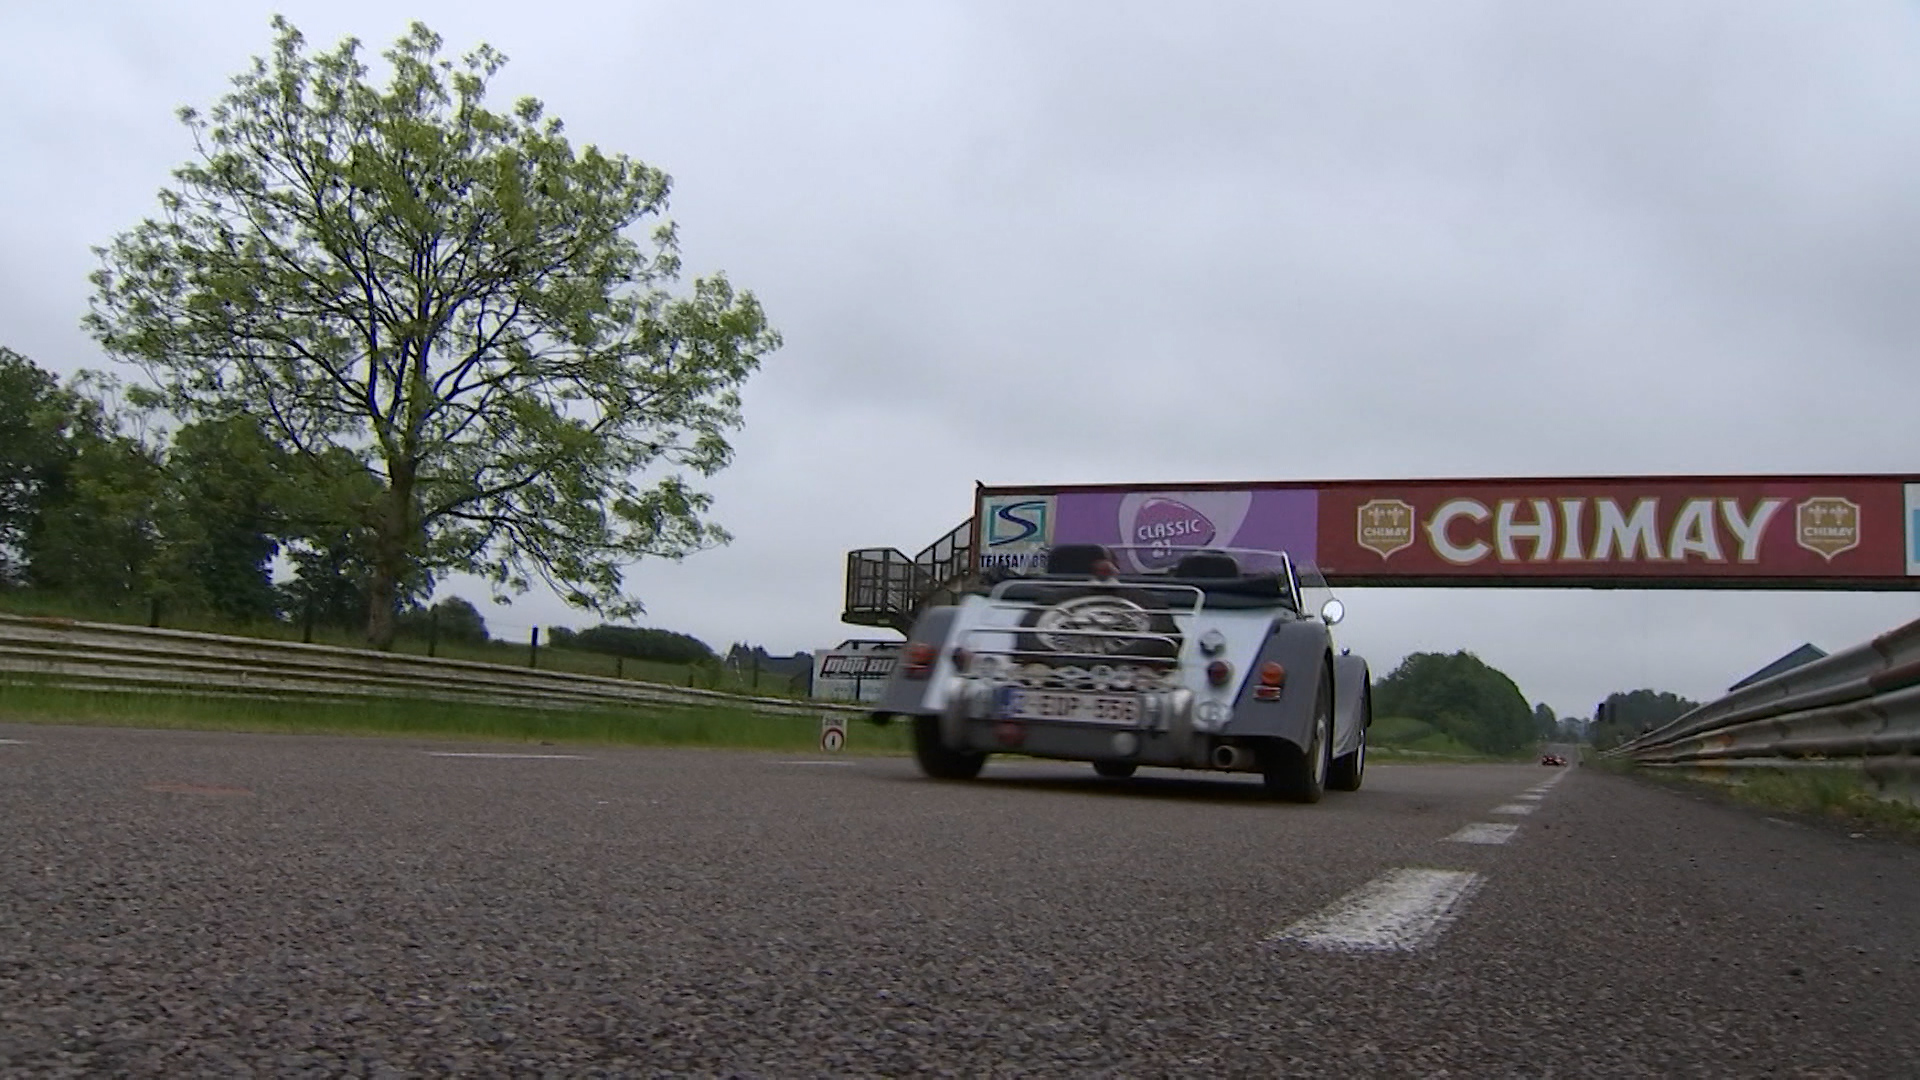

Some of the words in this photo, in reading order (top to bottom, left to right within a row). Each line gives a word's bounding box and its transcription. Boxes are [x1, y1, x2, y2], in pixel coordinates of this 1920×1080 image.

[1138, 519, 1201, 540] CLASSIC
[1363, 527, 1409, 537] CHIMAY
[1425, 498, 1790, 563] CHIMAY
[1803, 527, 1855, 537] CHIMAY
